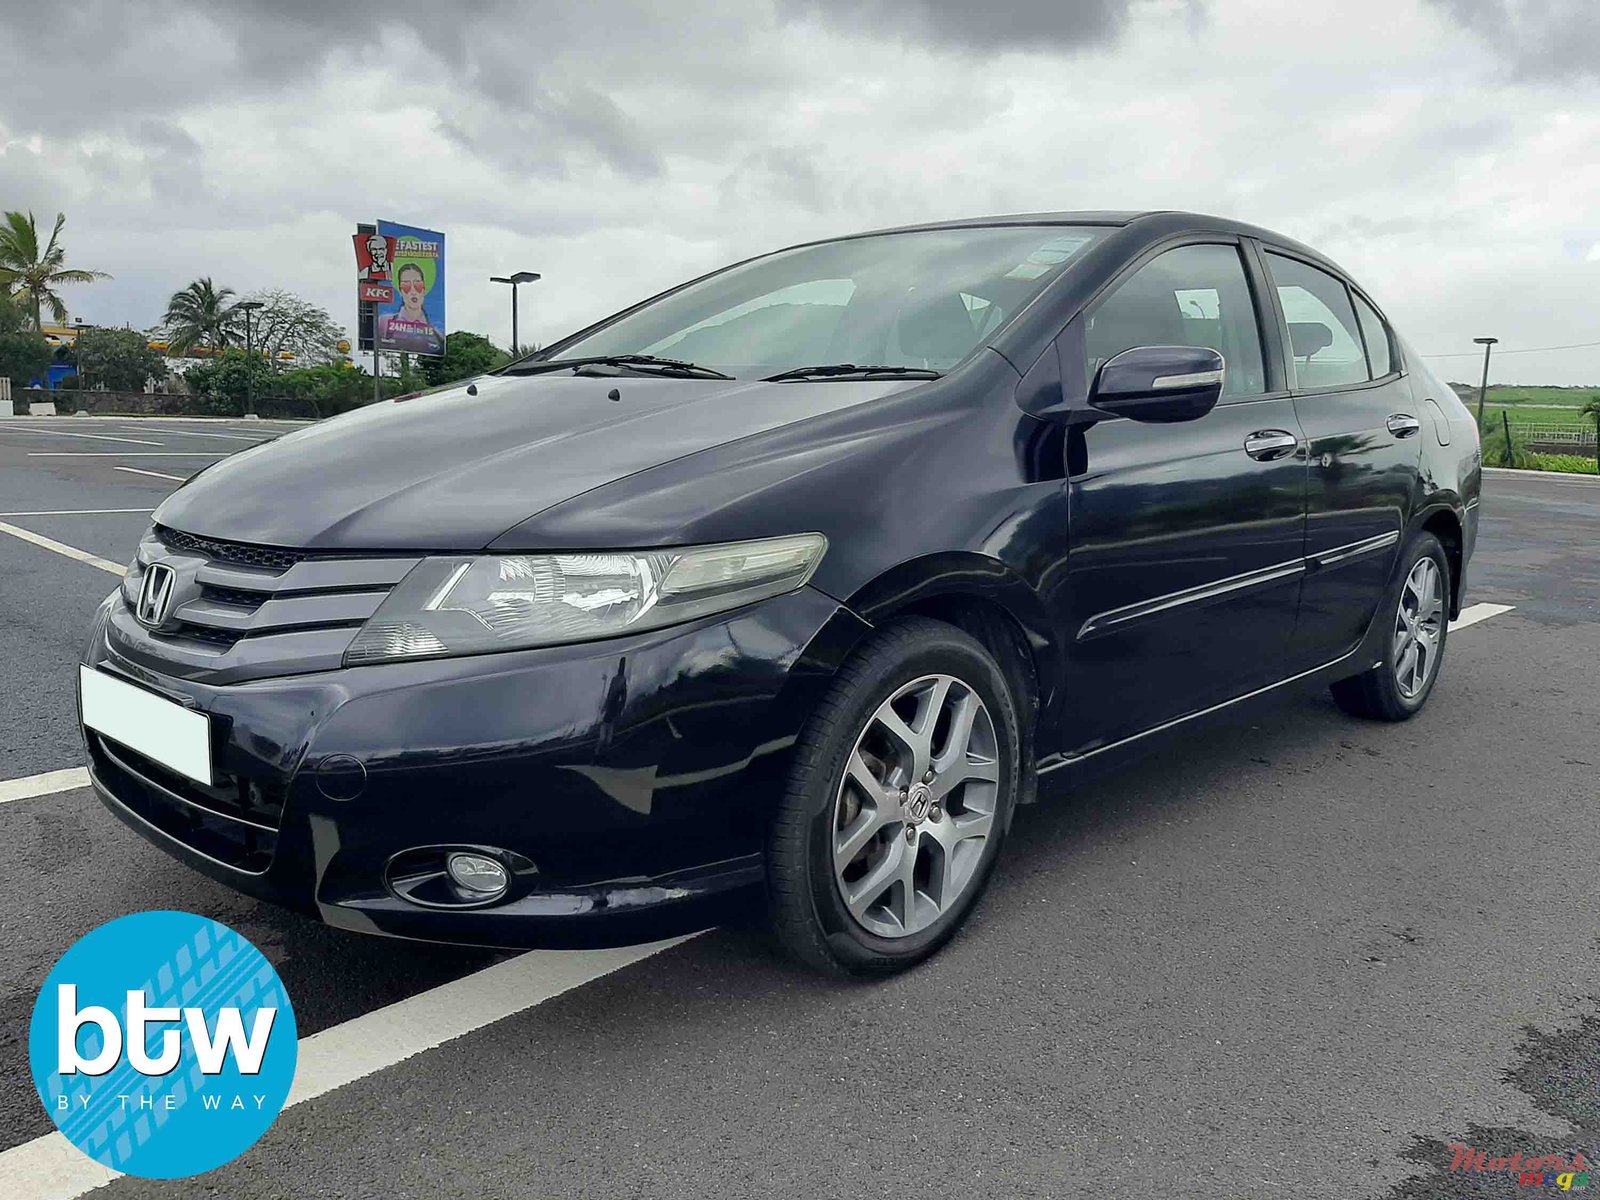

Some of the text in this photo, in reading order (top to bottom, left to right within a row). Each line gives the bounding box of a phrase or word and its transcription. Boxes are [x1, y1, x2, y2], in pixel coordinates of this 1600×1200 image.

[400, 241, 437, 251] FASTEST
[366, 287, 389, 298] KFC
[389, 322, 406, 332] 24H
